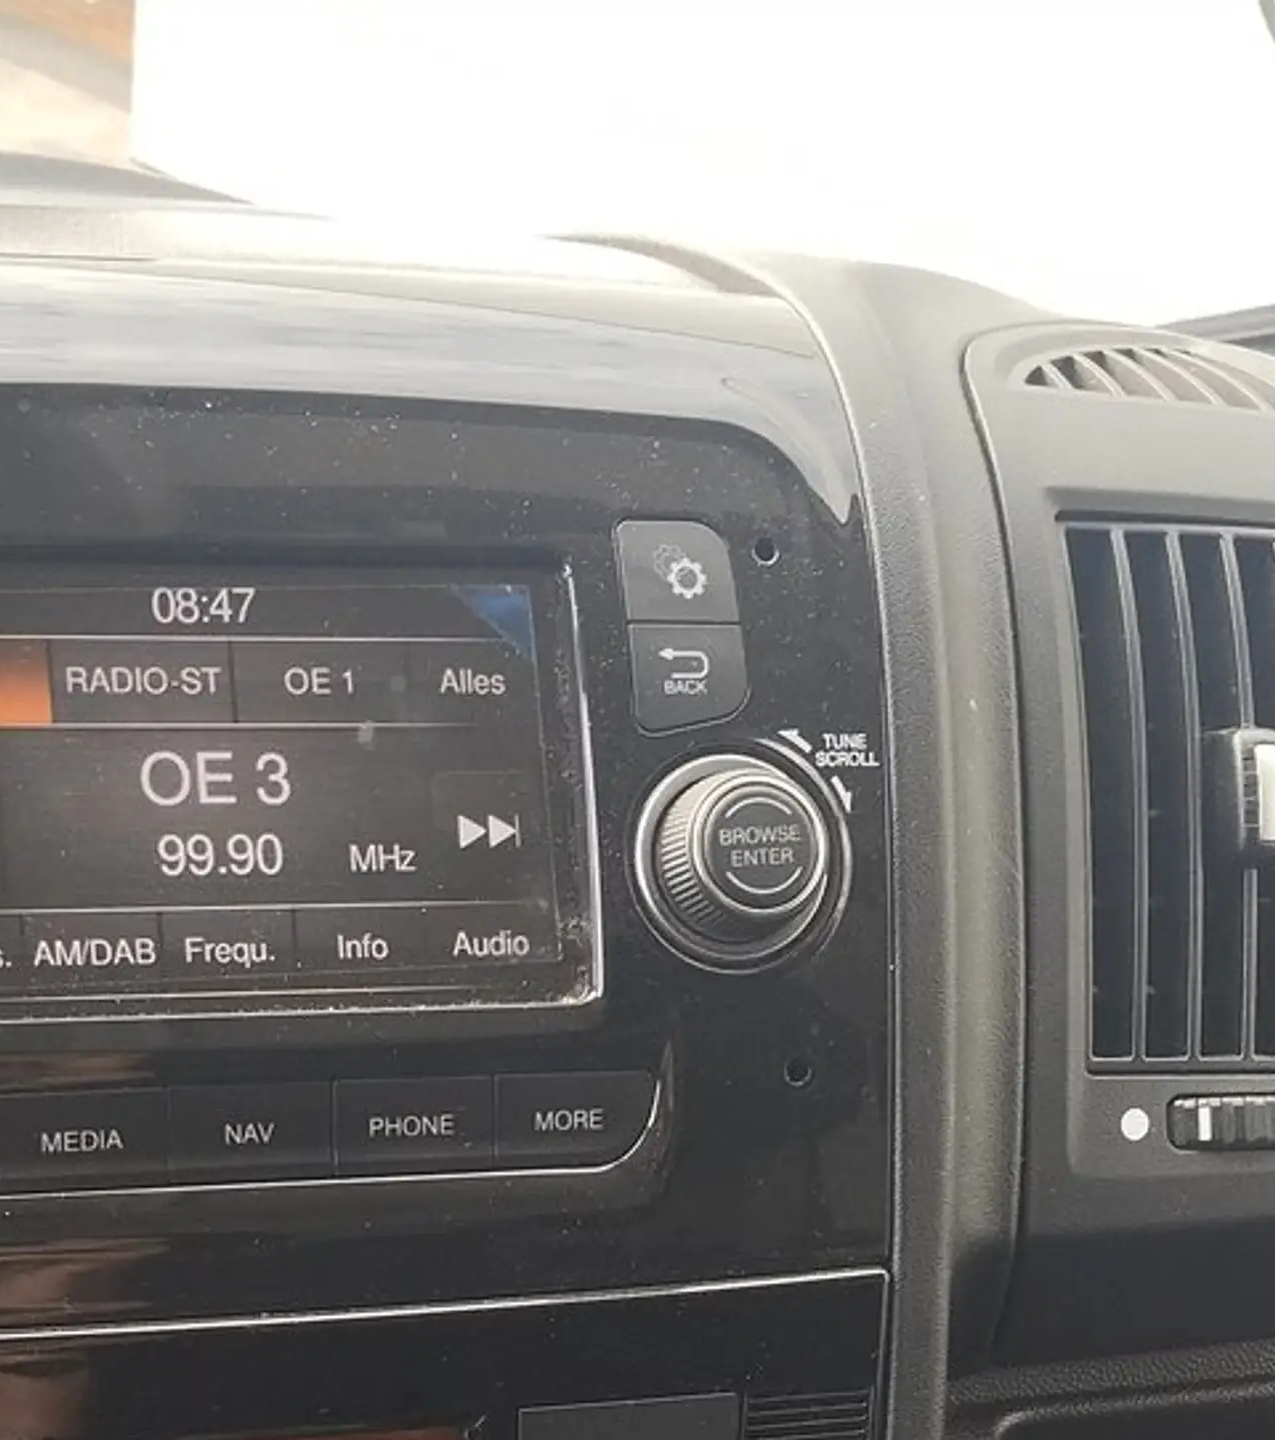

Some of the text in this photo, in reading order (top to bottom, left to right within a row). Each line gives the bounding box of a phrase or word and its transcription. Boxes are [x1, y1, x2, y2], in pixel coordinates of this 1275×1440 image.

[151, 587, 256, 625] 08:47
[65, 666, 221, 695] RADIO-ST
[284, 668, 355, 695] OE 1
[439, 667, 506, 695] Alles
[663, 680, 709, 696] BACK
[822, 733, 868, 751] TUNE
[814, 750, 881, 768] SCROLL
[140, 752, 292, 806] OE 3
[718, 824, 802, 847] BROWSE
[156, 833, 285, 878] 99.90
[349, 843, 418, 874] MHz
[730, 846, 795, 868] ENTER
[33, 938, 157, 968] AM/DAB
[184, 936, 277, 966] Frequ.
[337, 934, 389, 962] Info
[452, 930, 530, 958] Audio
[367, 1113, 456, 1138] PHONE
[533, 1107, 605, 1132] MORE
[40, 1129, 125, 1153] MEDIA
[224, 1122, 275, 1145] NAV
